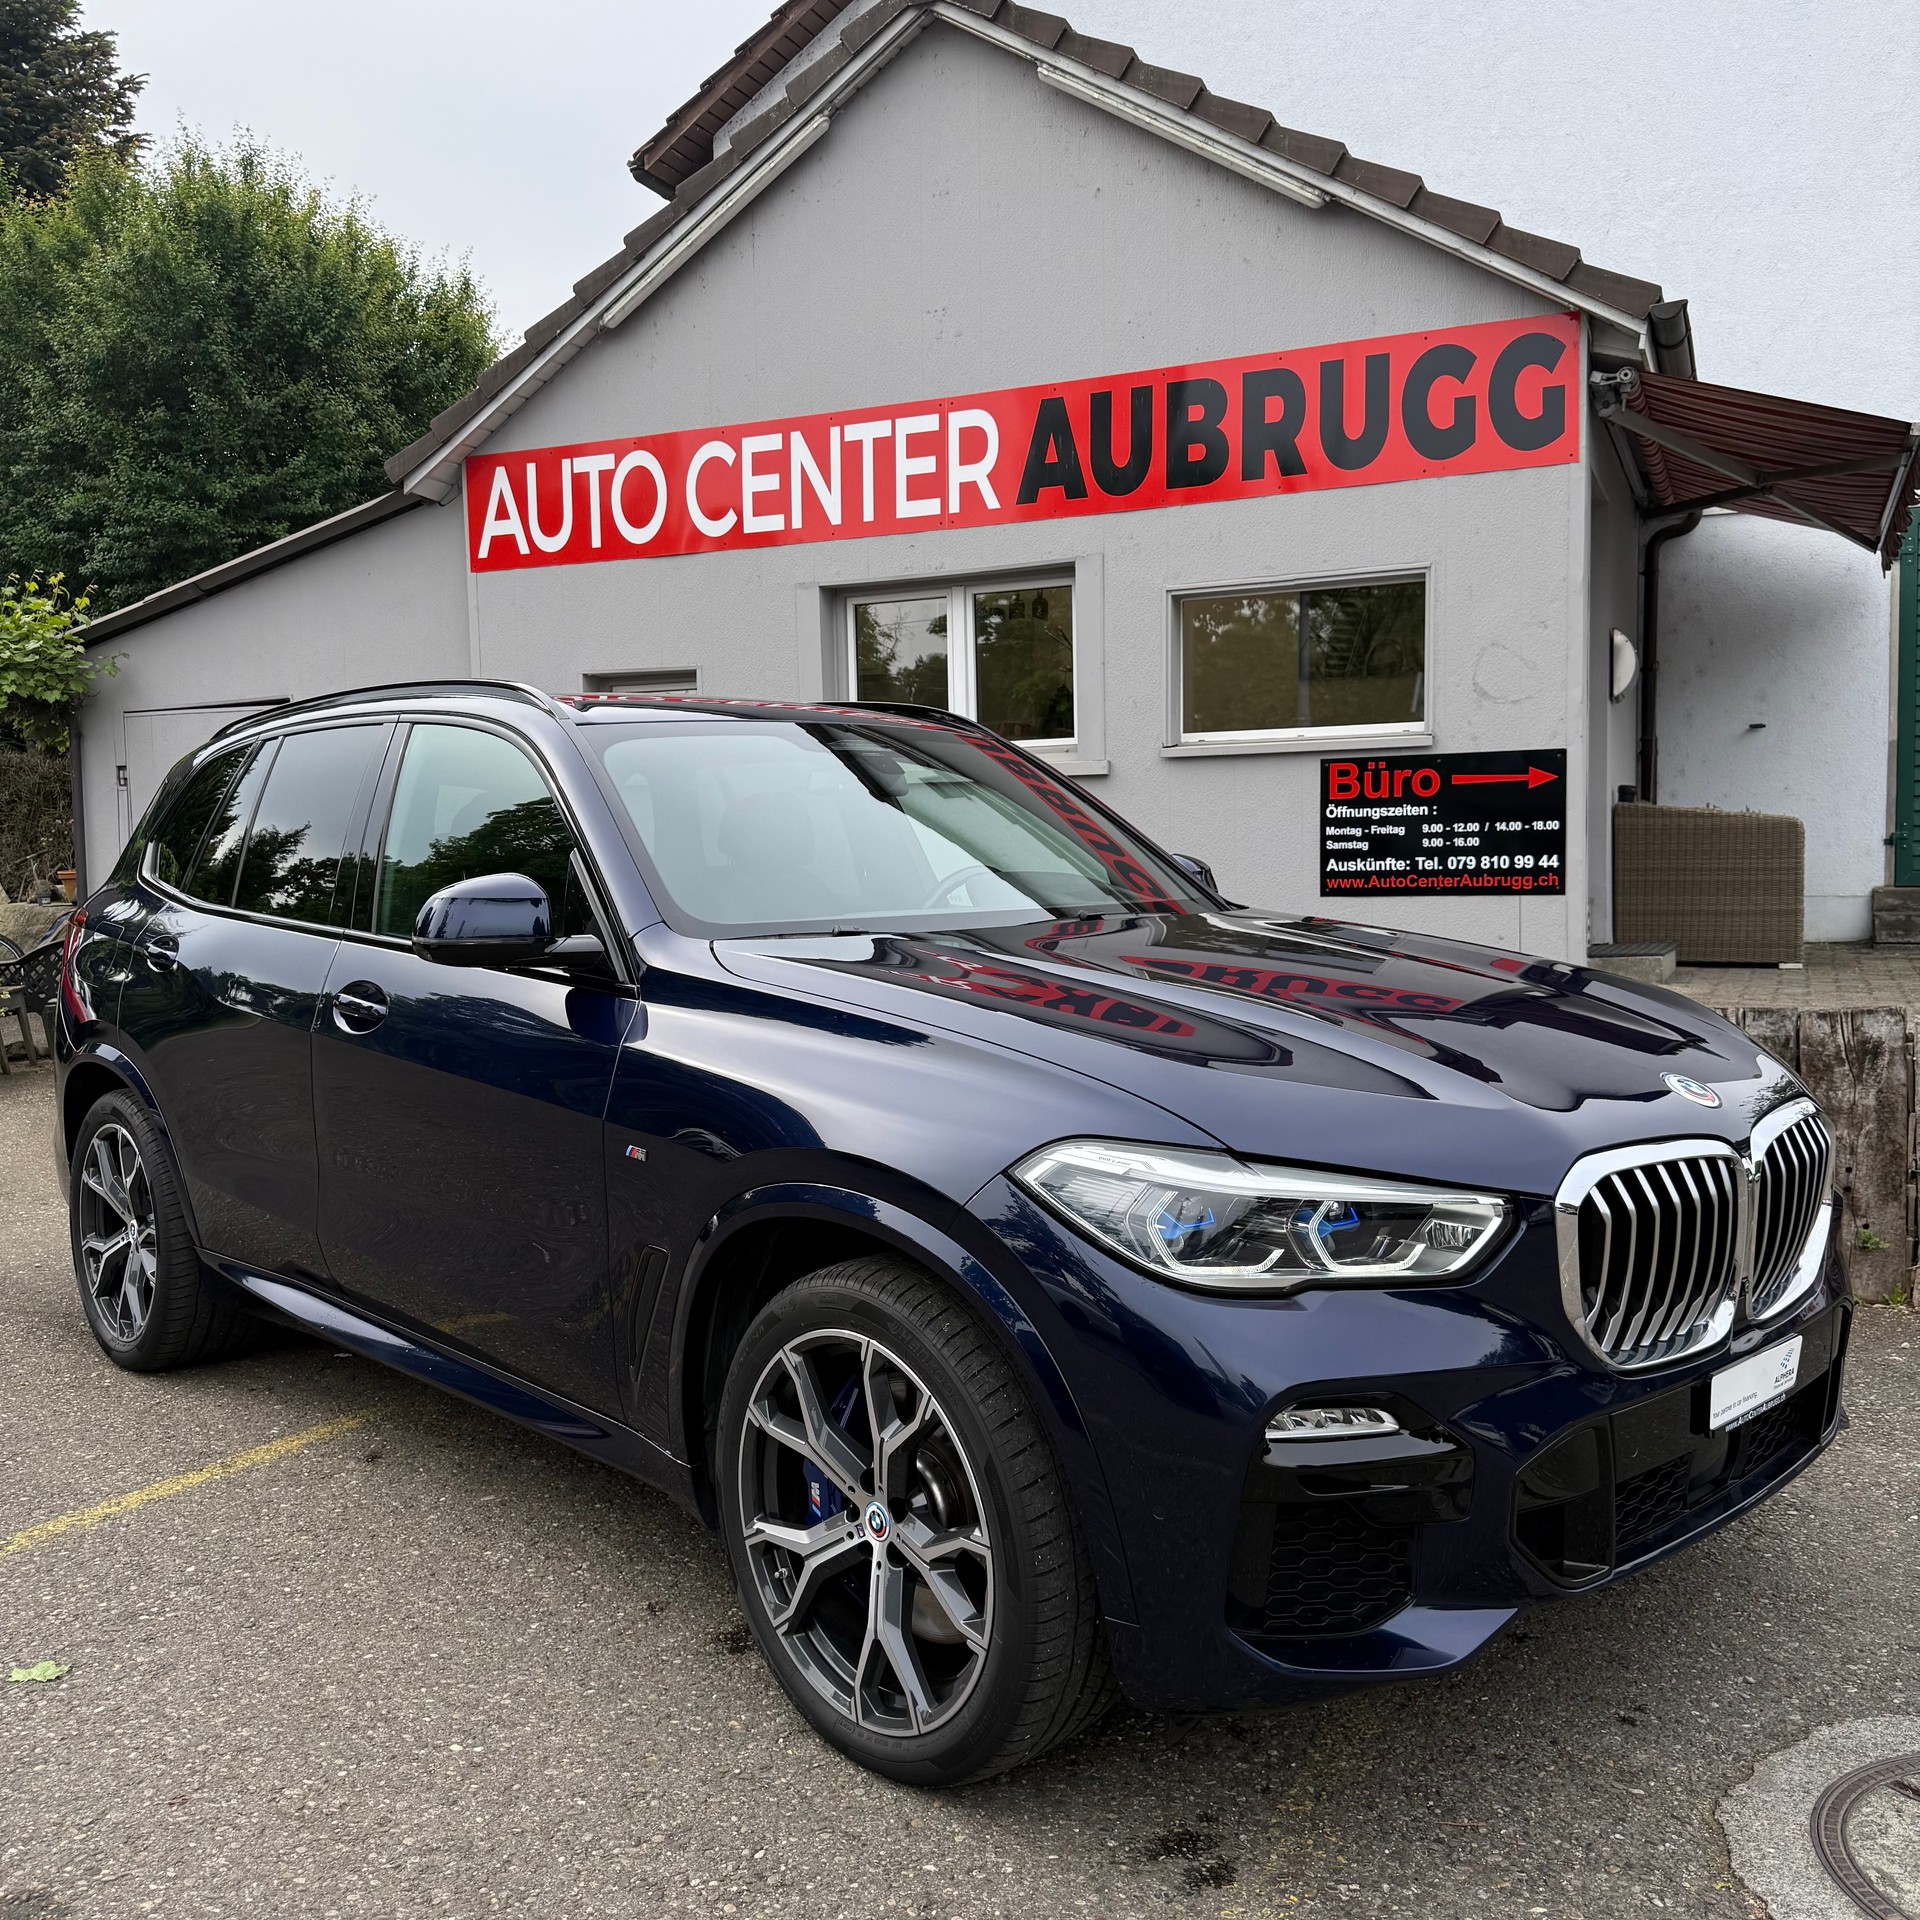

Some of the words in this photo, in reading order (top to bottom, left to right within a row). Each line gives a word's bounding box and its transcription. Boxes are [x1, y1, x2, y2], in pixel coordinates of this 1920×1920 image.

[478, 450, 668, 559] AUTO
[686, 408, 1001, 538] CENTER
[1016, 332, 1567, 506] AUBRUGG
[1329, 761, 1441, 800] Büro
[1326, 804, 1428, 820] Öffnungszeiten
[1326, 825, 1362, 837] Montag
[1371, 825, 1405, 836] Freitag
[1422, 823, 1443, 833] 9.00
[1453, 822, 1480, 833] 12.00
[1495, 821, 1522, 831] 14.00
[1532, 820, 1560, 830] 18.00
[1326, 839, 1369, 851] Samstag
[1422, 838, 1443, 848] 9.00
[1453, 837, 1480, 847] 16.00
[1326, 858, 1411, 872] Auskünfte:
[1415, 856, 1443, 870] Tel.
[1447, 856, 1476, 870] 079
[1480, 855, 1510, 869] 810
[1514, 855, 1534, 869] 99
[1539, 854, 1560, 868] 44
[1326, 872, 1560, 889] www.AutoCenterAubrugg.ch
